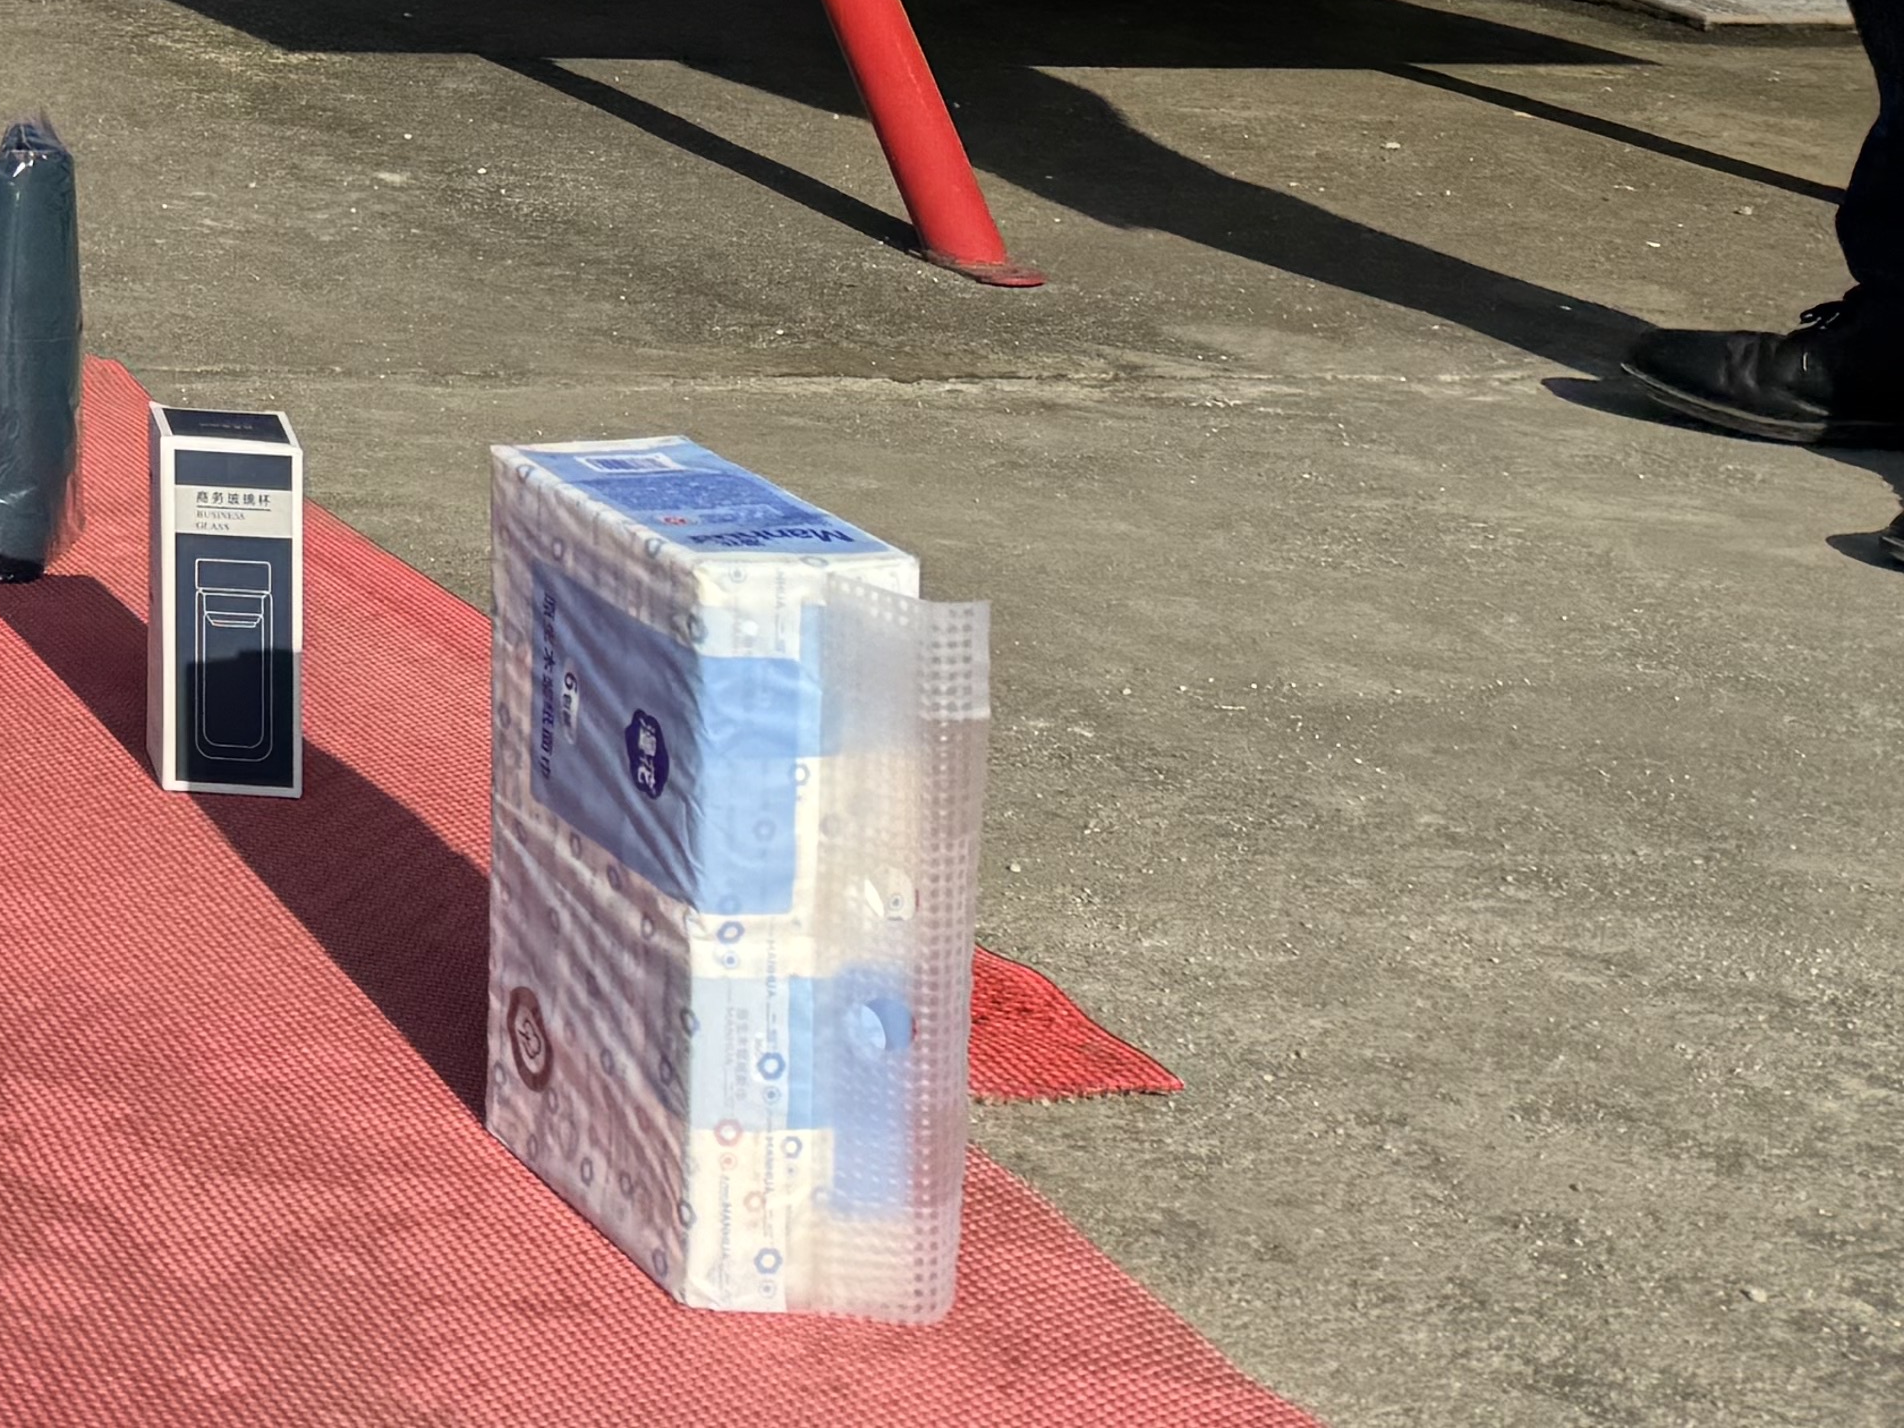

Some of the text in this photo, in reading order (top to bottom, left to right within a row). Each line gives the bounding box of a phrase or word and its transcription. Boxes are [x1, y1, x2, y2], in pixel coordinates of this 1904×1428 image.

[196, 490, 271, 508] 商务玻璃杯
[196, 510, 246, 521] BUSINESS
[195, 521, 230, 531] GLASS
